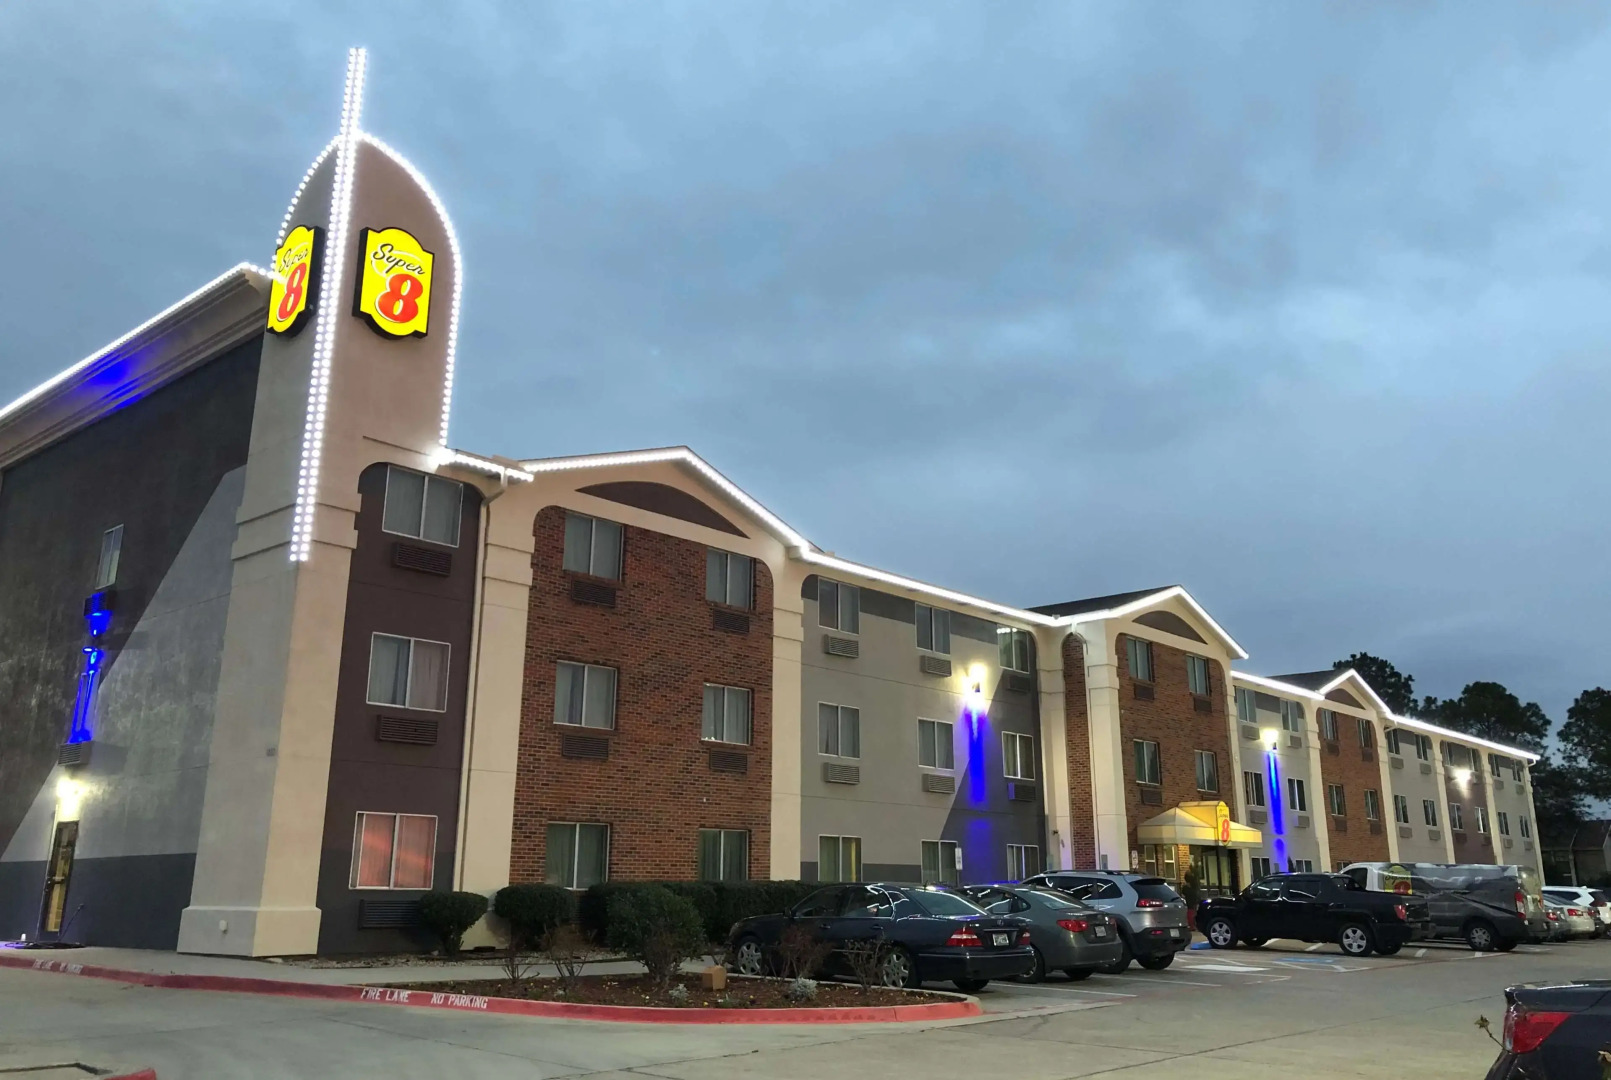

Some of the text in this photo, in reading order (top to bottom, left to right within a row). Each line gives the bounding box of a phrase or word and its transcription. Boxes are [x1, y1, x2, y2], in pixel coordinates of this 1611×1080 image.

[278, 248, 309, 276] Super
[372, 243, 425, 275] Super
[276, 262, 307, 322] 8
[375, 273, 424, 323] 8
[1221, 819, 1230, 843] 8
[361, 988, 489, 1009] FIRE LANE NO PARKING
